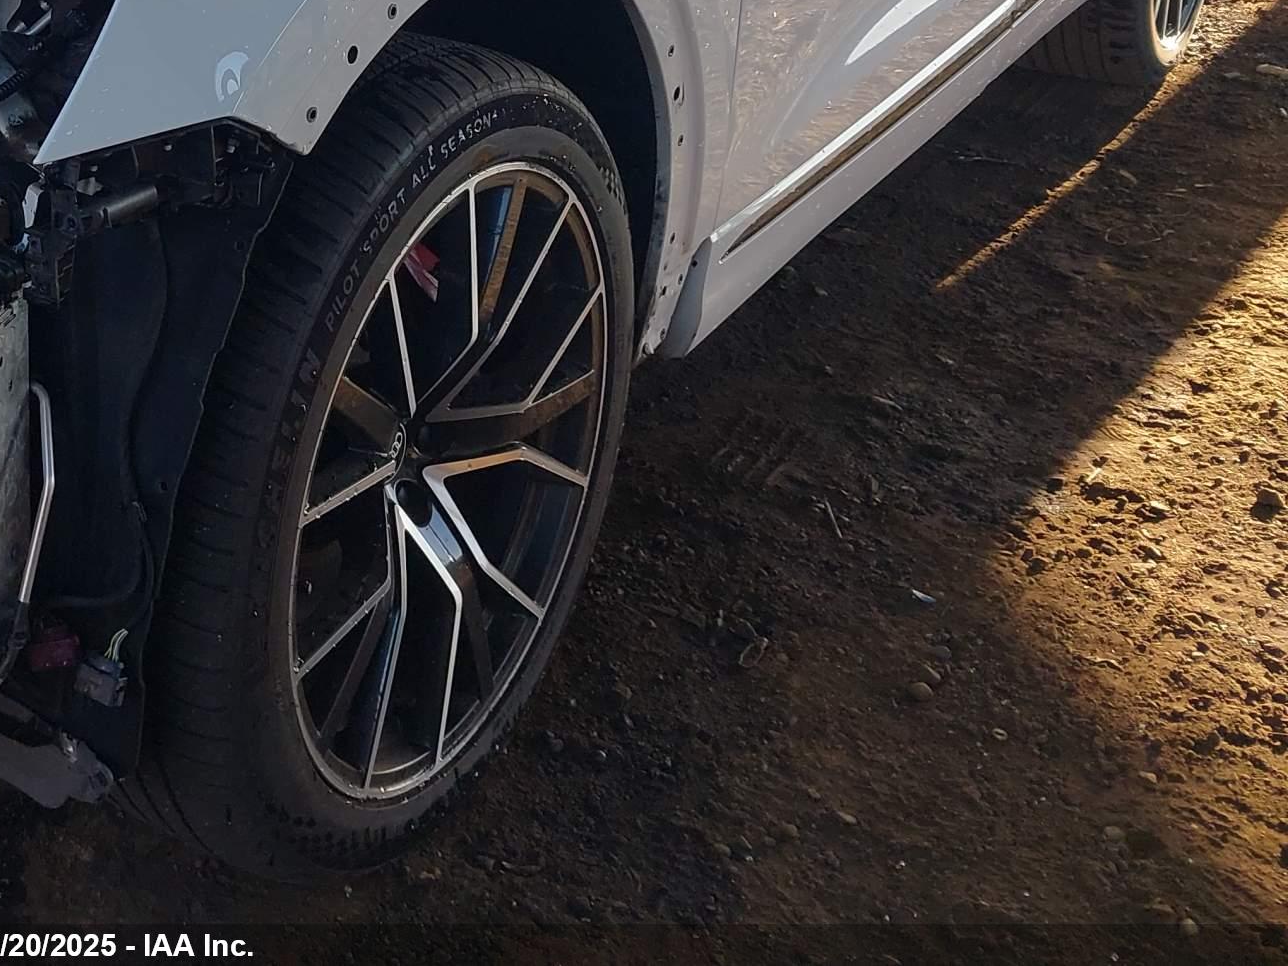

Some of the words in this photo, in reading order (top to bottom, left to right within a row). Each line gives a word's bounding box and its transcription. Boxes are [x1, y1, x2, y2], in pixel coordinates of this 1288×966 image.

[324, 258, 362, 332] PILOT
[362, 187, 407, 255] SPORT
[440, 112, 491, 158] SEASON
